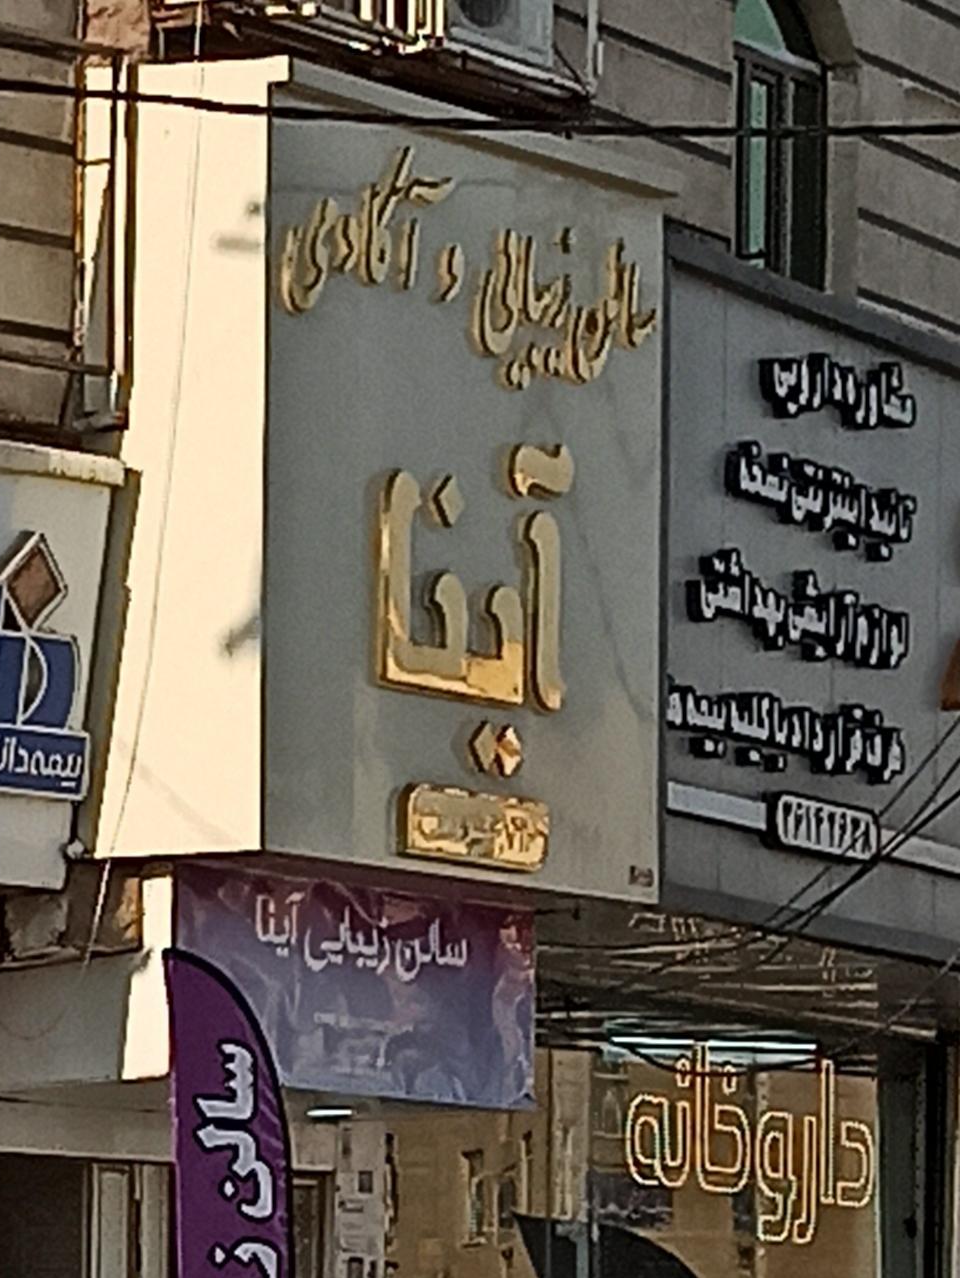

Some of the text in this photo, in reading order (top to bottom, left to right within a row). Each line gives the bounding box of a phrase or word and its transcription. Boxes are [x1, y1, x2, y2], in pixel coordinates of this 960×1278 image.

[254, 890, 468, 983] سالن زیبایی آینا
[195, 1041, 274, 1223] سالن
[625, 1041, 876, 1244] داروخانه
